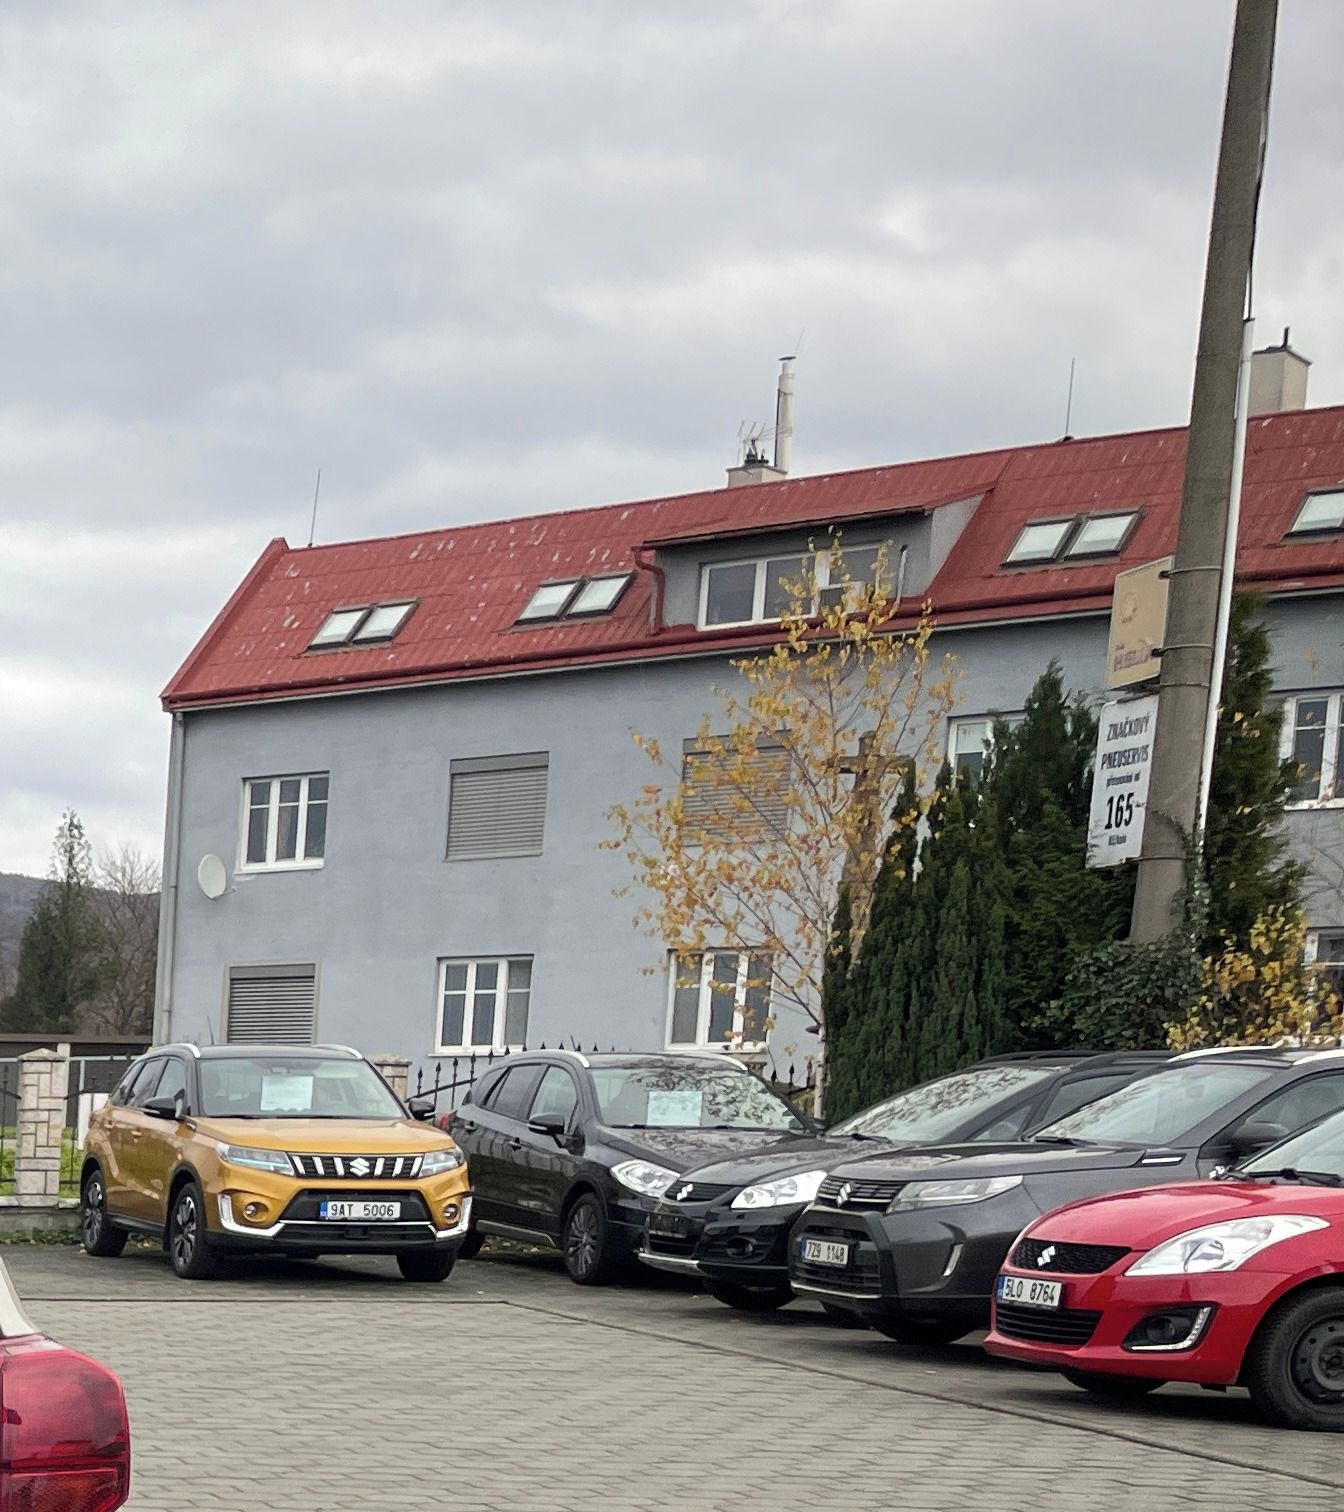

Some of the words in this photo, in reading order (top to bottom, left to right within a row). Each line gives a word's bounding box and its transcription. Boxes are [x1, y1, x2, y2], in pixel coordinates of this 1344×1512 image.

[1100, 744, 1149, 770] PNEUSERVIS
[1104, 792, 1134, 830] 165
[330, 1203, 353, 1217] 9AT
[363, 1203, 394, 1217] 5006
[1029, 1282, 1056, 1304] 8764
